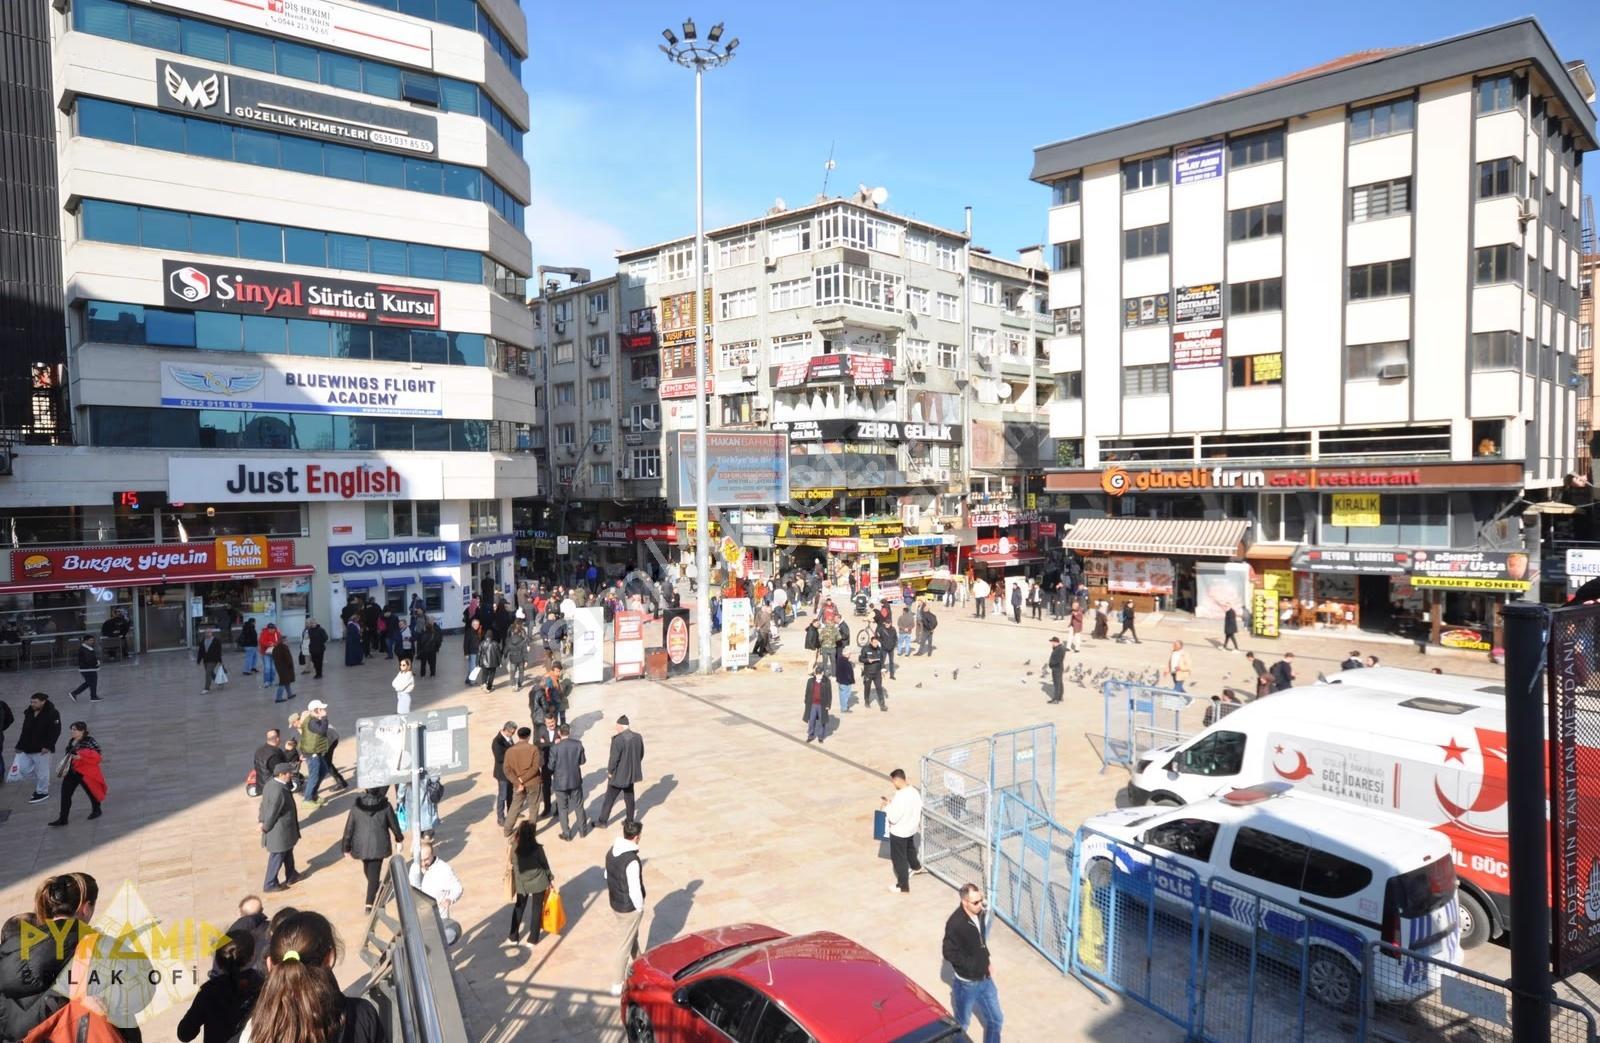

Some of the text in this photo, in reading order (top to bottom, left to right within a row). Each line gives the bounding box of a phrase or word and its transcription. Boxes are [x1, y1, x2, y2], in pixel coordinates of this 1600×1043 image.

[235, 106, 369, 140] GÜZELLİK HİZMETLERİ
[374, 132, 393, 144] 0535
[216, 274, 304, 312] Sinyal
[308, 285, 376, 310] Sürücü
[381, 293, 436, 316] Kursu
[1177, 298, 1220, 309] SİSTEMLERİ
[286, 372, 436, 393] BLUEWINGS FLIGHT
[180, 399, 204, 407] 0212
[328, 391, 398, 406] ACADEMY
[794, 421, 818, 430] ZEHRA
[858, 422, 952, 440] ZEHRA GELİNLİK
[711, 437, 741, 446] HAKAN
[226, 464, 401, 499] Just English
[1135, 469, 1207, 491] güneli
[1211, 468, 1265, 488] fırın
[1269, 470, 1307, 487] cafe
[1319, 468, 1422, 486] restaurant
[121, 491, 138, 505] 15
[1334, 494, 1378, 511] KİRALIK
[824, 526, 850, 536] DÖNERİ
[222, 540, 262, 557] Tavuk
[379, 546, 446, 566] YapıKredi
[1434, 552, 1485, 561] DÖNERCİ
[62, 550, 208, 573] Burger yiyelim
[227, 556, 262, 567] yiyelim
[1470, 561, 1506, 571] Usta
[1416, 579, 1524, 589] BAYBURT DÖNERİ
[1322, 769, 1385, 794] GÖÇ İDARESİ
[1322, 784, 1385, 805] BAŞKANLIĞI
[1564, 640, 1578, 942] SADETTİN TANTAN MEYDANI
[1148, 869, 1193, 898] POLİS
